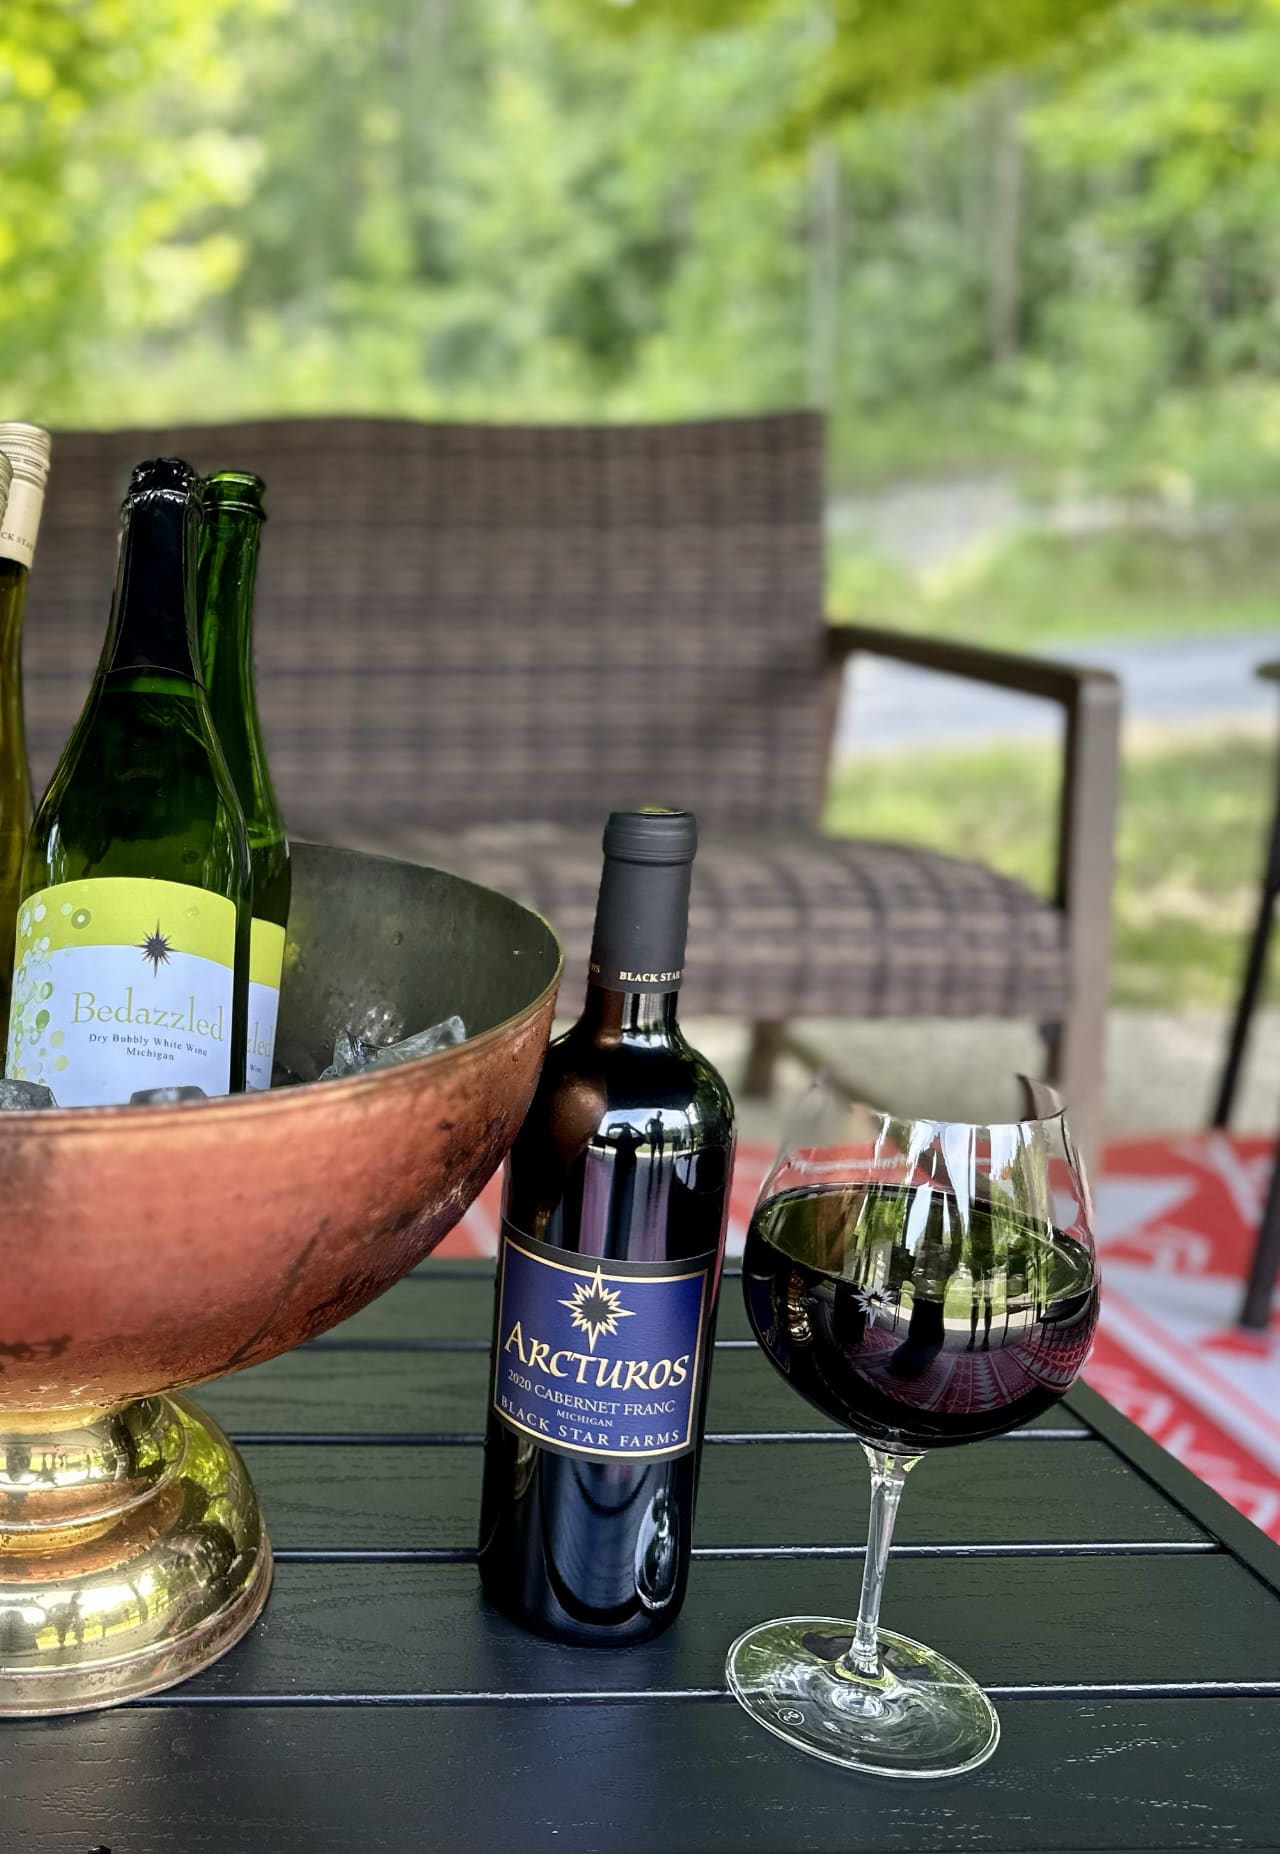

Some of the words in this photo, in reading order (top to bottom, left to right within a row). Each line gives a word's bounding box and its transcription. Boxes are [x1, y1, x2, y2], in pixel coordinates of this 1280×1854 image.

[619, 971, 659, 983] BLACK
[659, 970, 681, 982] STAR
[71, 987, 224, 1042] Bedazzled
[88, 1033, 108, 1044] Dry
[112, 1033, 150, 1047] Bubbly
[153, 1037, 183, 1050] White
[186, 1043, 209, 1057] Wine
[126, 1047, 175, 1062] Michigan
[503, 1320, 690, 1391] ARCTUROS
[507, 1369, 532, 1392] 2020
[534, 1384, 621, 1415] CABERNET
[623, 1400, 676, 1416] FRANC
[501, 1395, 550, 1432] BLACK
[558, 1425, 610, 1446] STAR
[619, 1429, 680, 1448] FARMS
[556, 1409, 614, 1428] MICHIGAN
